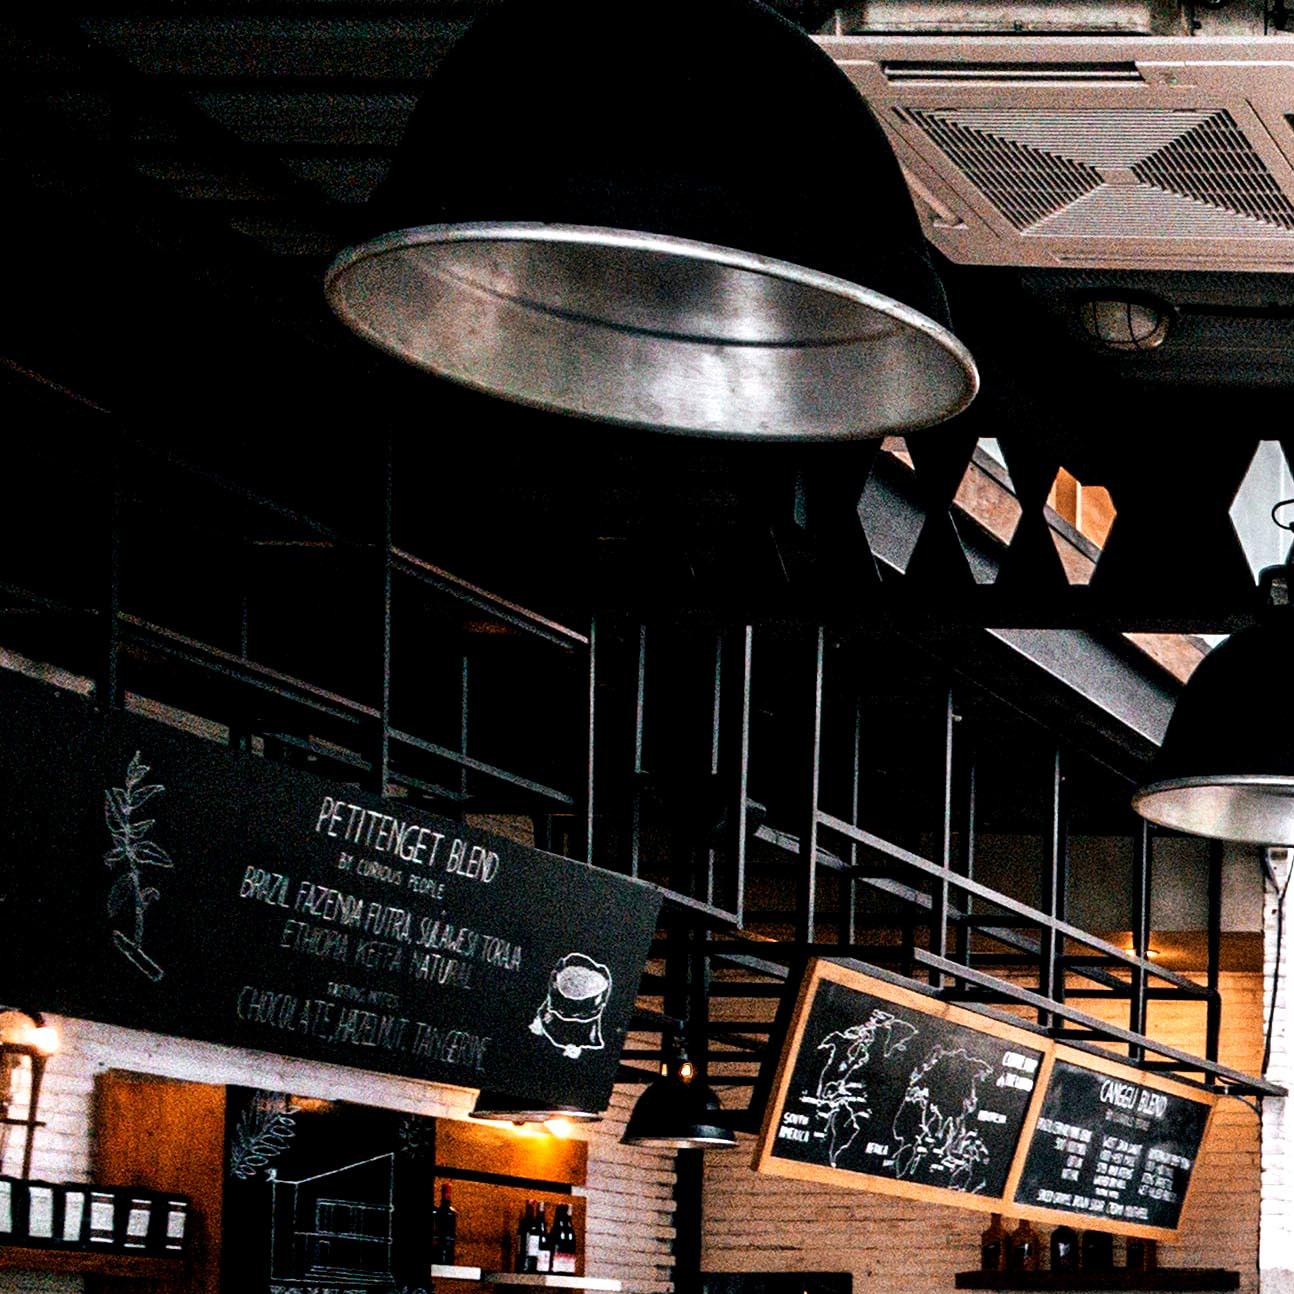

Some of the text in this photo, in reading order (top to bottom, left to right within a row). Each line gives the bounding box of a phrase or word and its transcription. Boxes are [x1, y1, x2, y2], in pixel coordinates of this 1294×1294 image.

[316, 797, 499, 883] PETITENGET BLEND
[240, 866, 289, 908] BRAZIL
[295, 881, 363, 927] FAZENDA
[338, 852, 447, 900] BY CURIOUS PEOPLE
[1137, 1090, 1168, 1117] BLEND
